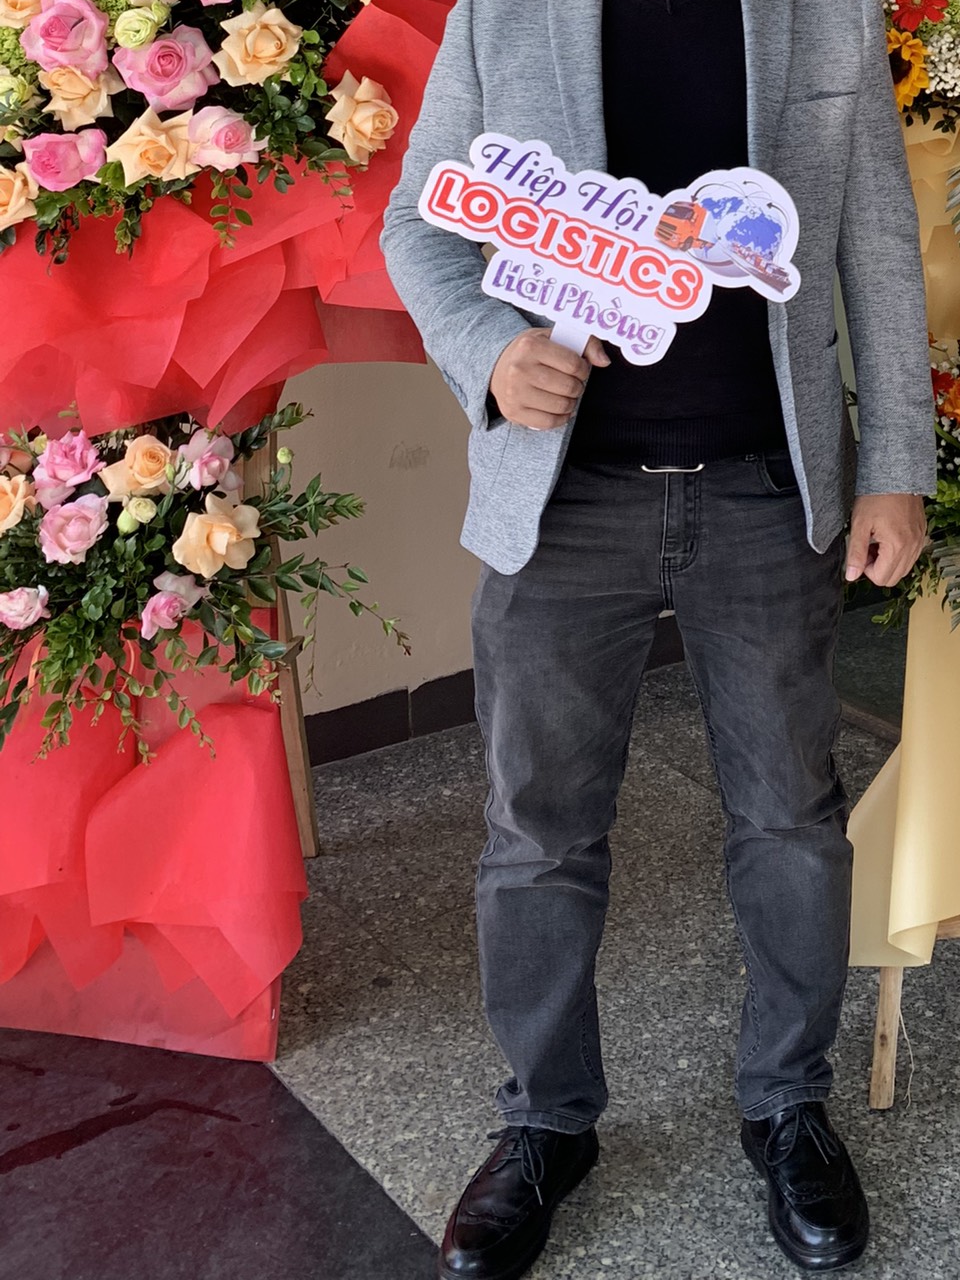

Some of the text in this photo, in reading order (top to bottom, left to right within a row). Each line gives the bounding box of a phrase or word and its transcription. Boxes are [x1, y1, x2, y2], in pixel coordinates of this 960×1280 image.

[481, 143, 654, 233] Hiệp Hội
[429, 170, 702, 309] LOGISTICS
[492, 259, 667, 356] Hải Phòng
